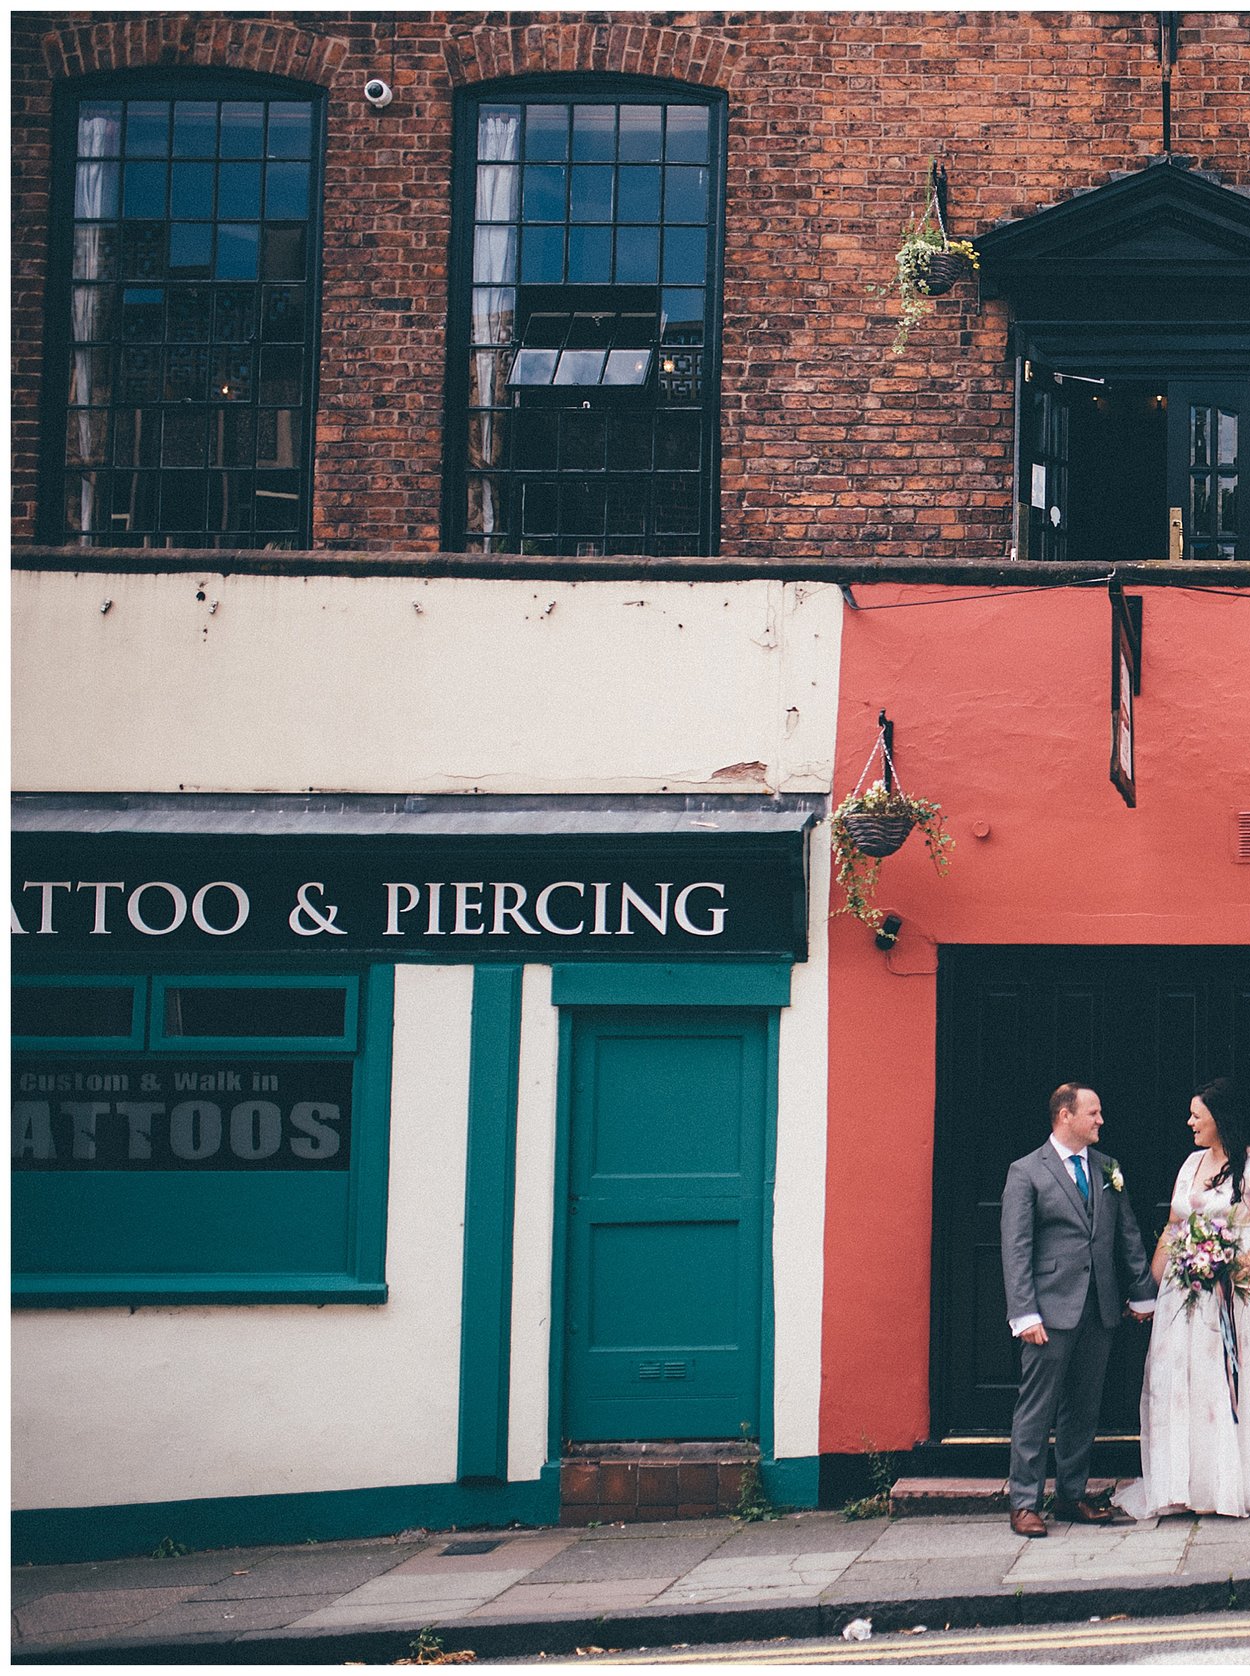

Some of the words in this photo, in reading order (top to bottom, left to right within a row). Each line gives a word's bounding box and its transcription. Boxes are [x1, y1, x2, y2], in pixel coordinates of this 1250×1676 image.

[288, 881, 348, 936] &
[382, 881, 730, 937] PIERCING
[140, 1071, 162, 1092] &
[174, 1071, 242, 1091] Walk
[252, 1071, 279, 1091] in
